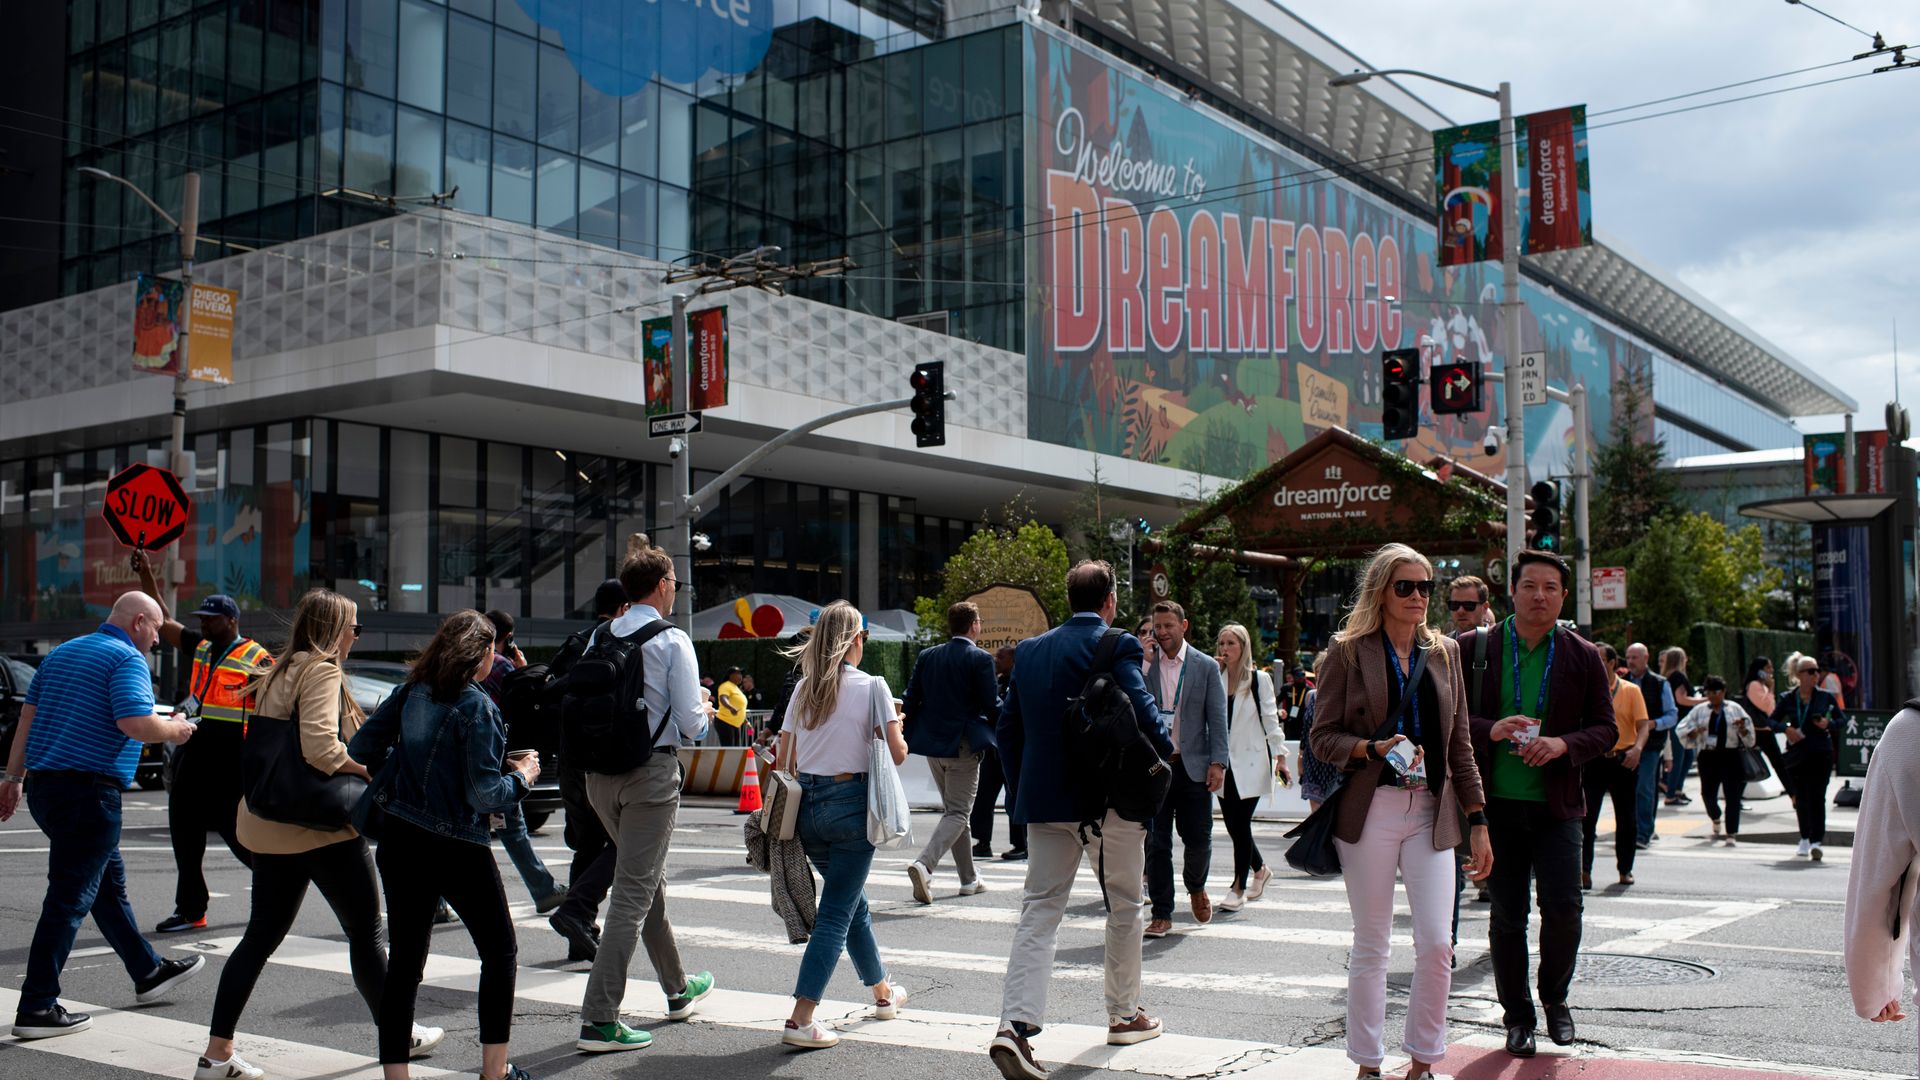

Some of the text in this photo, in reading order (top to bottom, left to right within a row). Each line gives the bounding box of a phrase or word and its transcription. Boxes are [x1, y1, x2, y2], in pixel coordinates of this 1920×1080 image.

[1055, 107, 1207, 201] Welcome to
[1537, 138, 1557, 226] dreamforce
[193, 288, 230, 304] DIEGO
[192, 299, 233, 315] RIVERA
[699, 329, 710, 391] dreamforce
[1523, 392, 1536, 402] ED
[653, 419, 685, 432] ONE WAY
[1273, 481, 1392, 509] dreamforce
[115, 487, 175, 527] SLOW
[1300, 510, 1368, 521] NATIONAL PARK
[1846, 738, 1880, 746] DETOU
